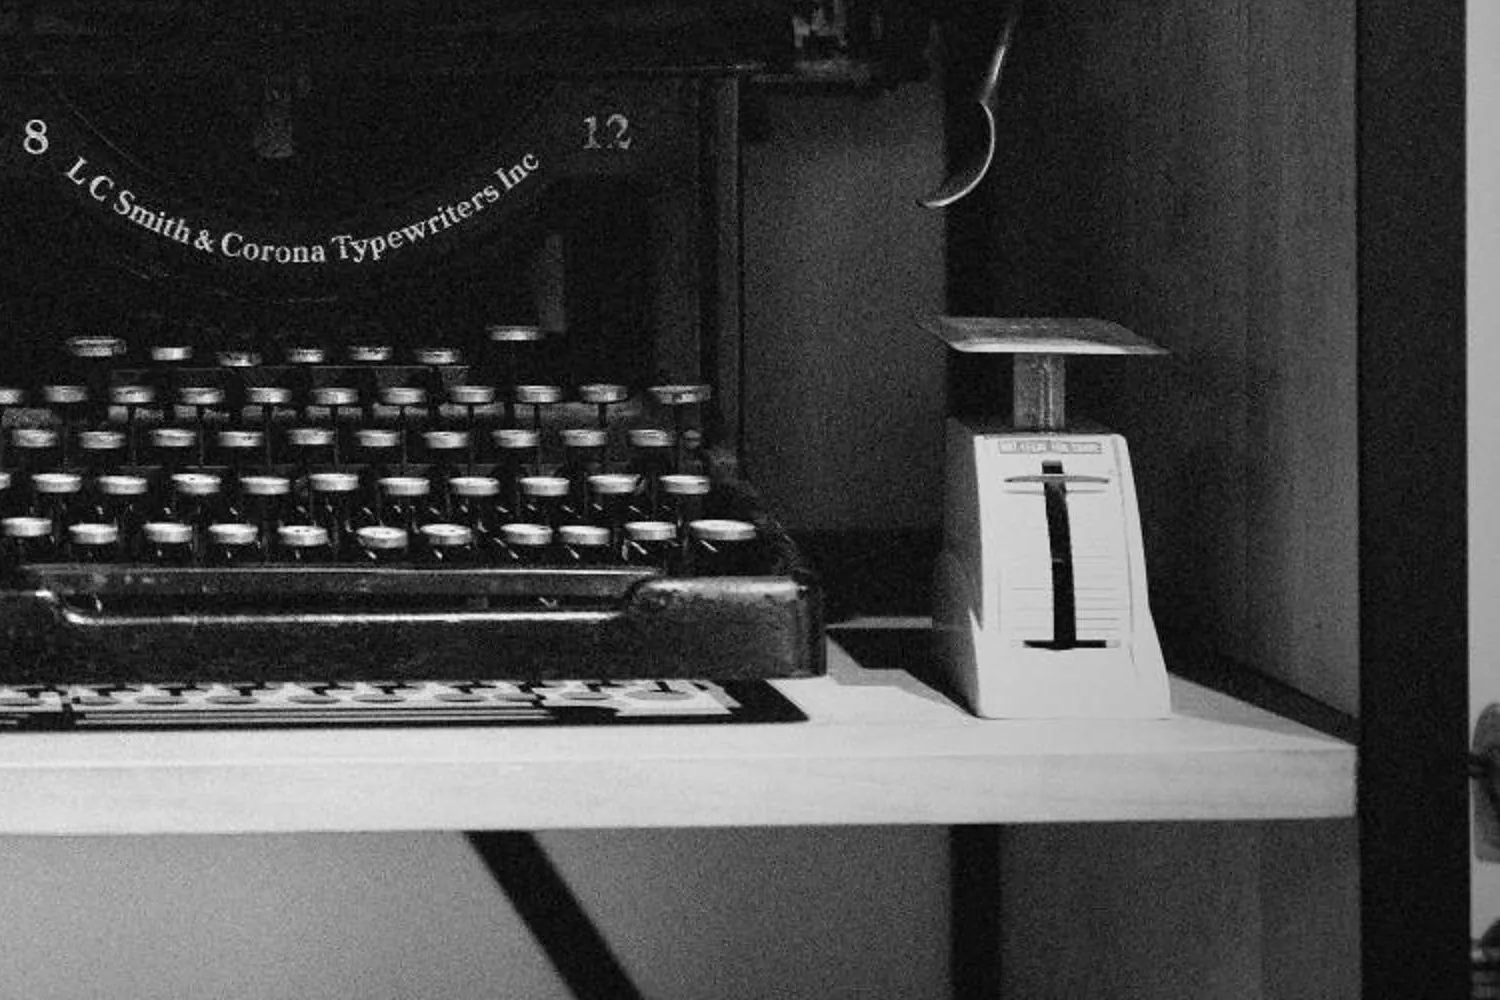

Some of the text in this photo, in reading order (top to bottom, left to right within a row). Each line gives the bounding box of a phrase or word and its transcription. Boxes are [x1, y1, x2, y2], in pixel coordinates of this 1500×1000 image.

[22, 119, 49, 154] 8
[581, 113, 632, 151] 12
[65, 150, 540, 265] L C Smith & Corona Typewriters Inc
